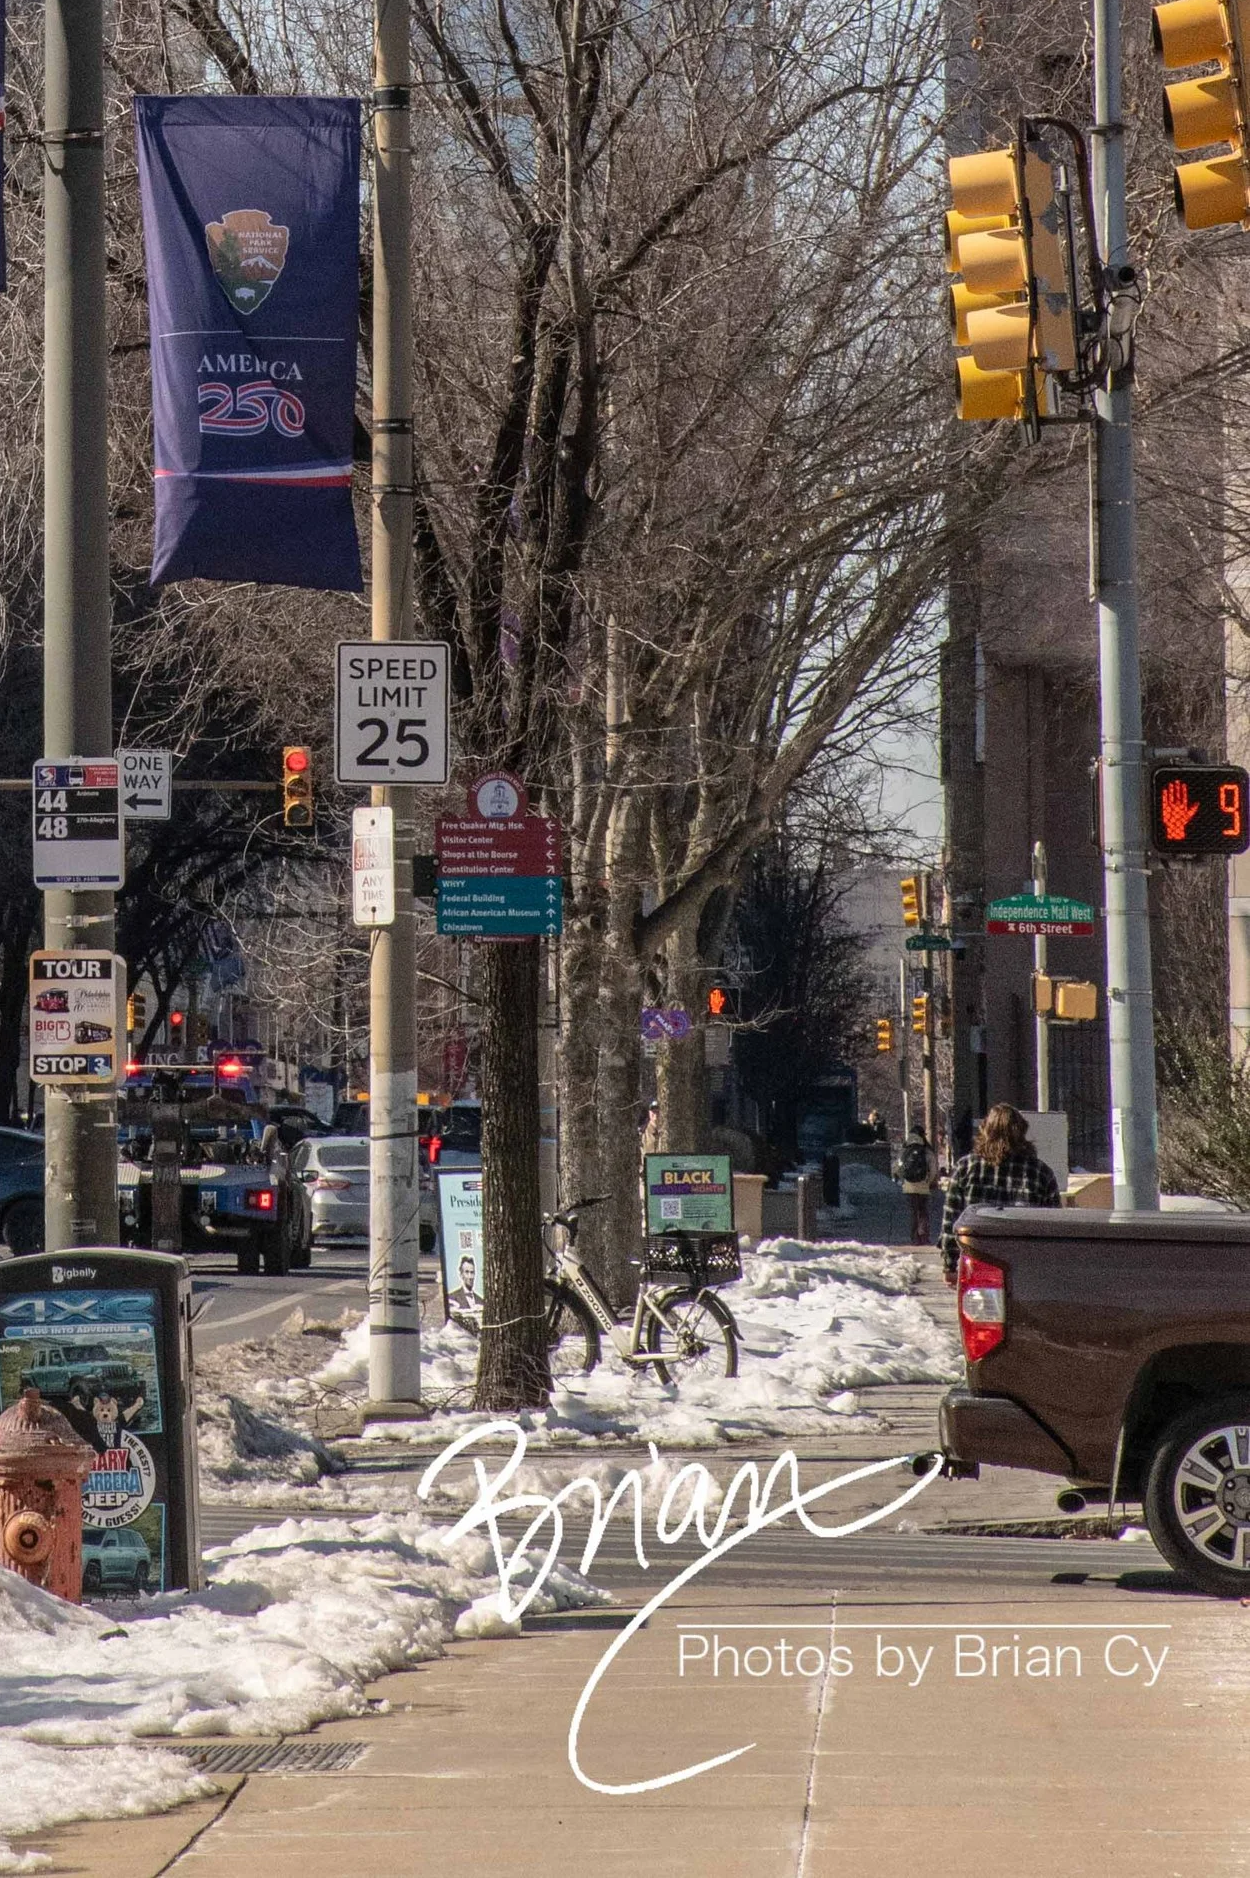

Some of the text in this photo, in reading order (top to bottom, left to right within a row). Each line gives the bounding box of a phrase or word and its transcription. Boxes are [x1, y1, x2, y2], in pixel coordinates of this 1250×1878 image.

[238, 231, 283, 239] NATIONAL
[198, 380, 305, 437] 250
[349, 658, 437, 680] SPEED
[358, 686, 427, 707] LIMIT
[356, 718, 430, 767] 25
[124, 756, 163, 771] ONE
[123, 775, 162, 789] WAY
[37, 790, 68, 812] 44
[1219, 784, 1240, 835] 9
[38, 816, 68, 838] 48
[460, 822, 487, 830] Quaker
[442, 851, 465, 860] Shops
[442, 865, 515, 873] Constitution Center
[362, 876, 384, 887] ANY
[362, 890, 385, 901] TIME
[442, 894, 505, 903] Federal Building
[990, 905, 1091, 921] Independence Mall West
[442, 923, 483, 931] Chinatown
[1018, 923, 1073, 934] 6th Street
[43, 960, 101, 978] TOUR
[35, 1020, 55, 1031] BIG
[36, 1057, 106, 1073] STOP 3
[664, 1171, 712, 1184] BLACK
[582, 1288, 612, 1330] zoomo
[0, 1345, 20, 1354] Jeep
[123, 1434, 138, 1449] THE
[83, 1493, 129, 1506] JEEP
